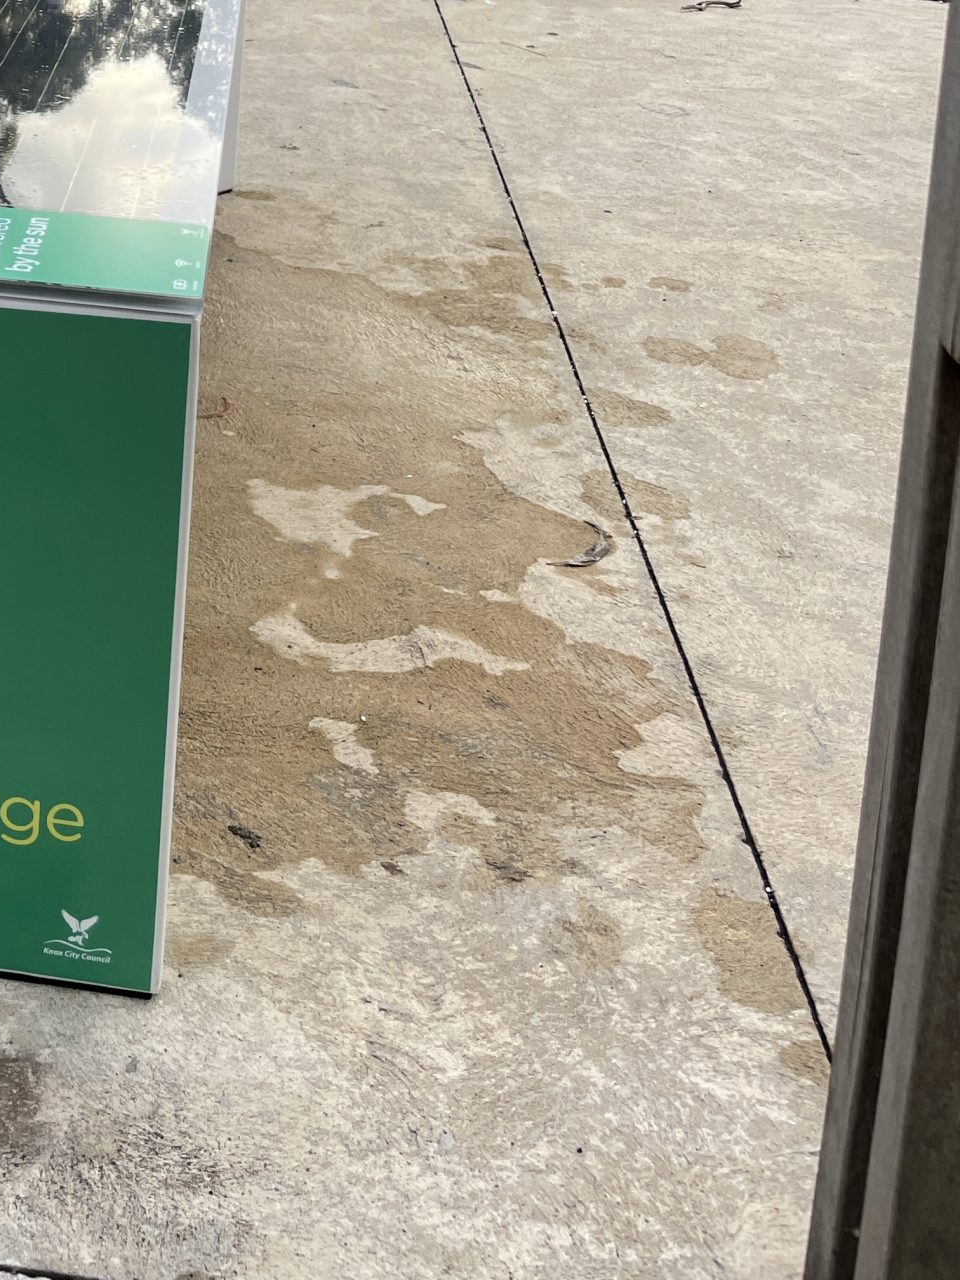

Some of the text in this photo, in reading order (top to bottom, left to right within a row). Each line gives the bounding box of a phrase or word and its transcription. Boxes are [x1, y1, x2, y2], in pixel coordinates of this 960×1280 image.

[4, 217, 50, 272] by the sun
[43, 947, 111, 963] Knox City Council
